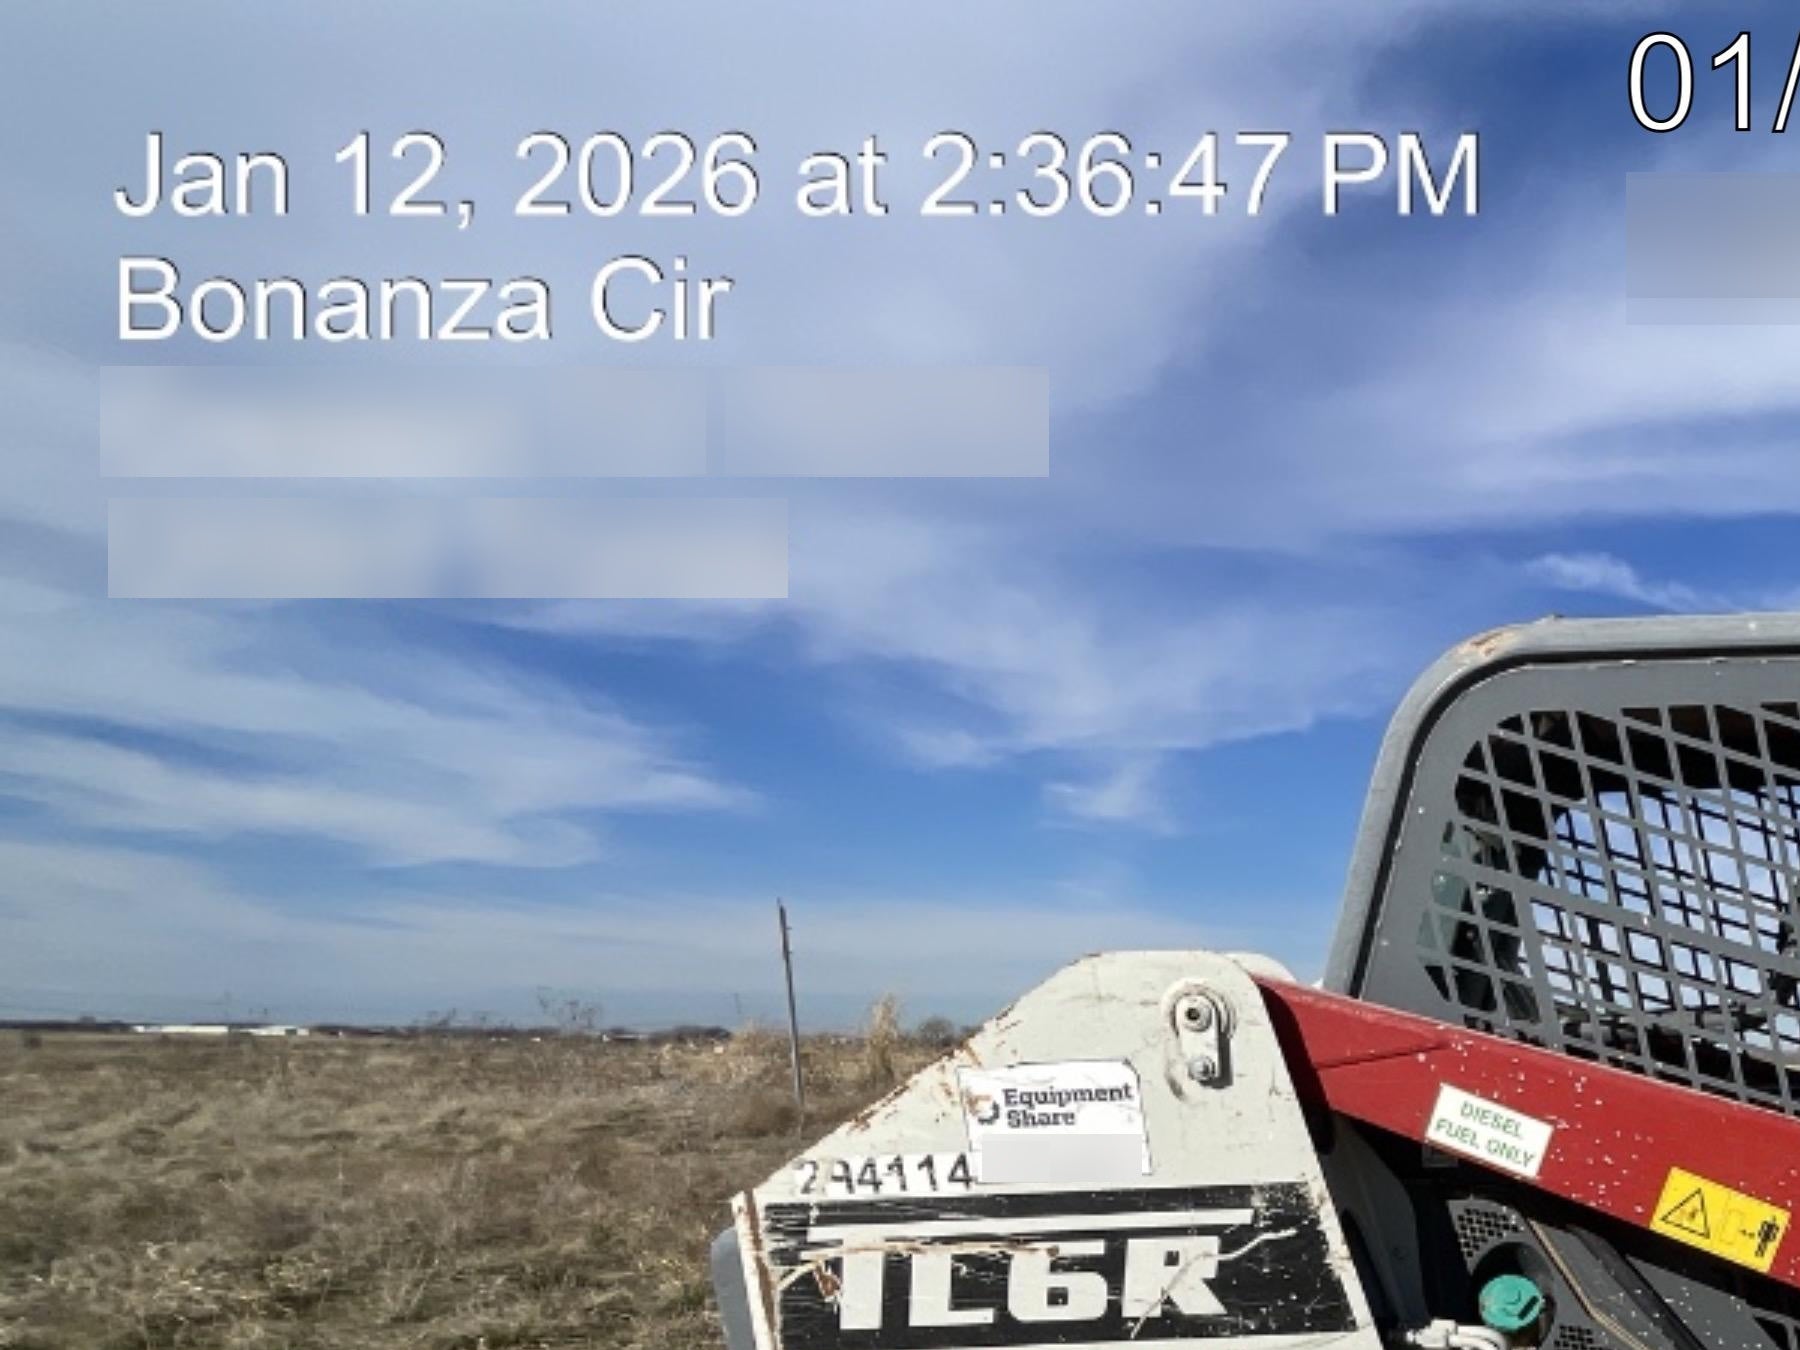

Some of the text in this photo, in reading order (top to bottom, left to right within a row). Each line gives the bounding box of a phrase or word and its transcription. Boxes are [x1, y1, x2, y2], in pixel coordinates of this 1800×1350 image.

[1002, 1083, 1134, 1109] Equipment
[1006, 1109, 1076, 1129] Share
[1460, 1101, 1524, 1139] DIESEL
[1435, 1118, 1537, 1169] FUEL ONLY
